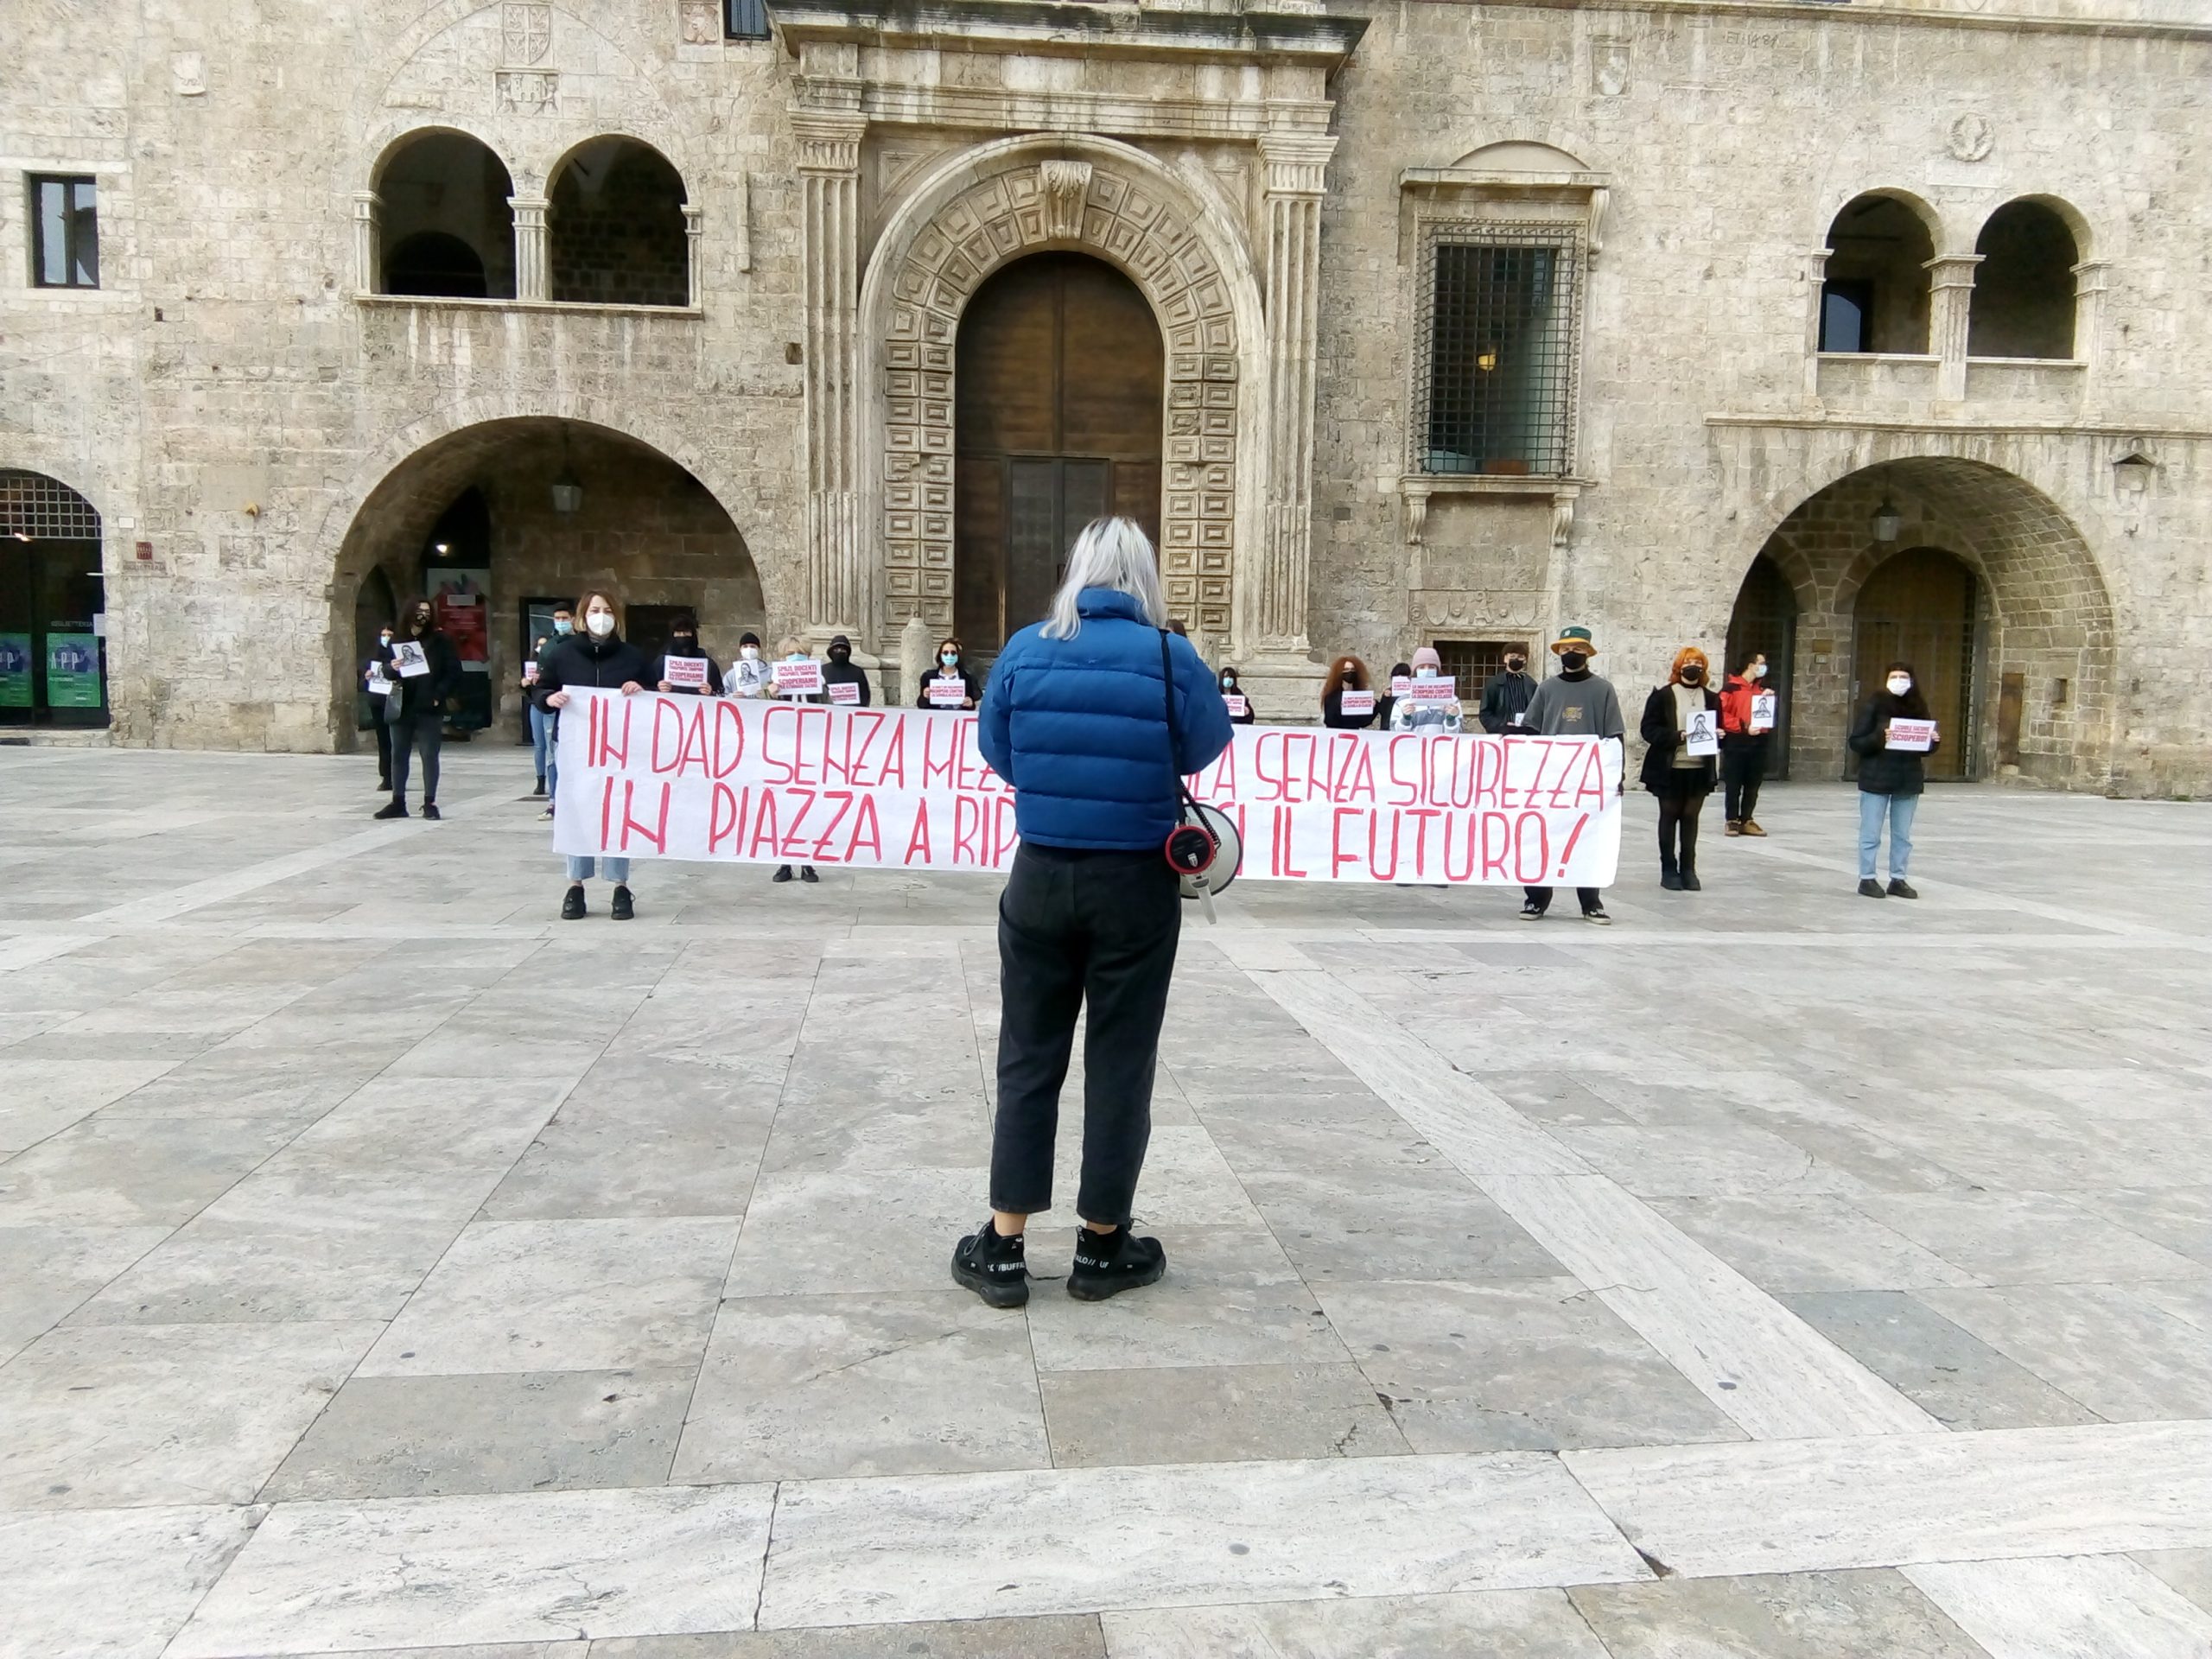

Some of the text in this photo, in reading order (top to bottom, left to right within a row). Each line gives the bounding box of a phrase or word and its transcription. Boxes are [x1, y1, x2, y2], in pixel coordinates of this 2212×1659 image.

[588, 696, 631, 770] IN
[652, 697, 745, 779] DAD
[762, 706, 906, 790] SENZA
[1255, 732, 1376, 804] SENZA
[1388, 734, 1605, 811] SICUREZZA
[601, 776, 671, 855] IN
[709, 782, 882, 862] PIAZZA
[904, 797, 931, 865] A
[1272, 804, 1307, 877] IL
[1332, 807, 1590, 884] FUTURO!
